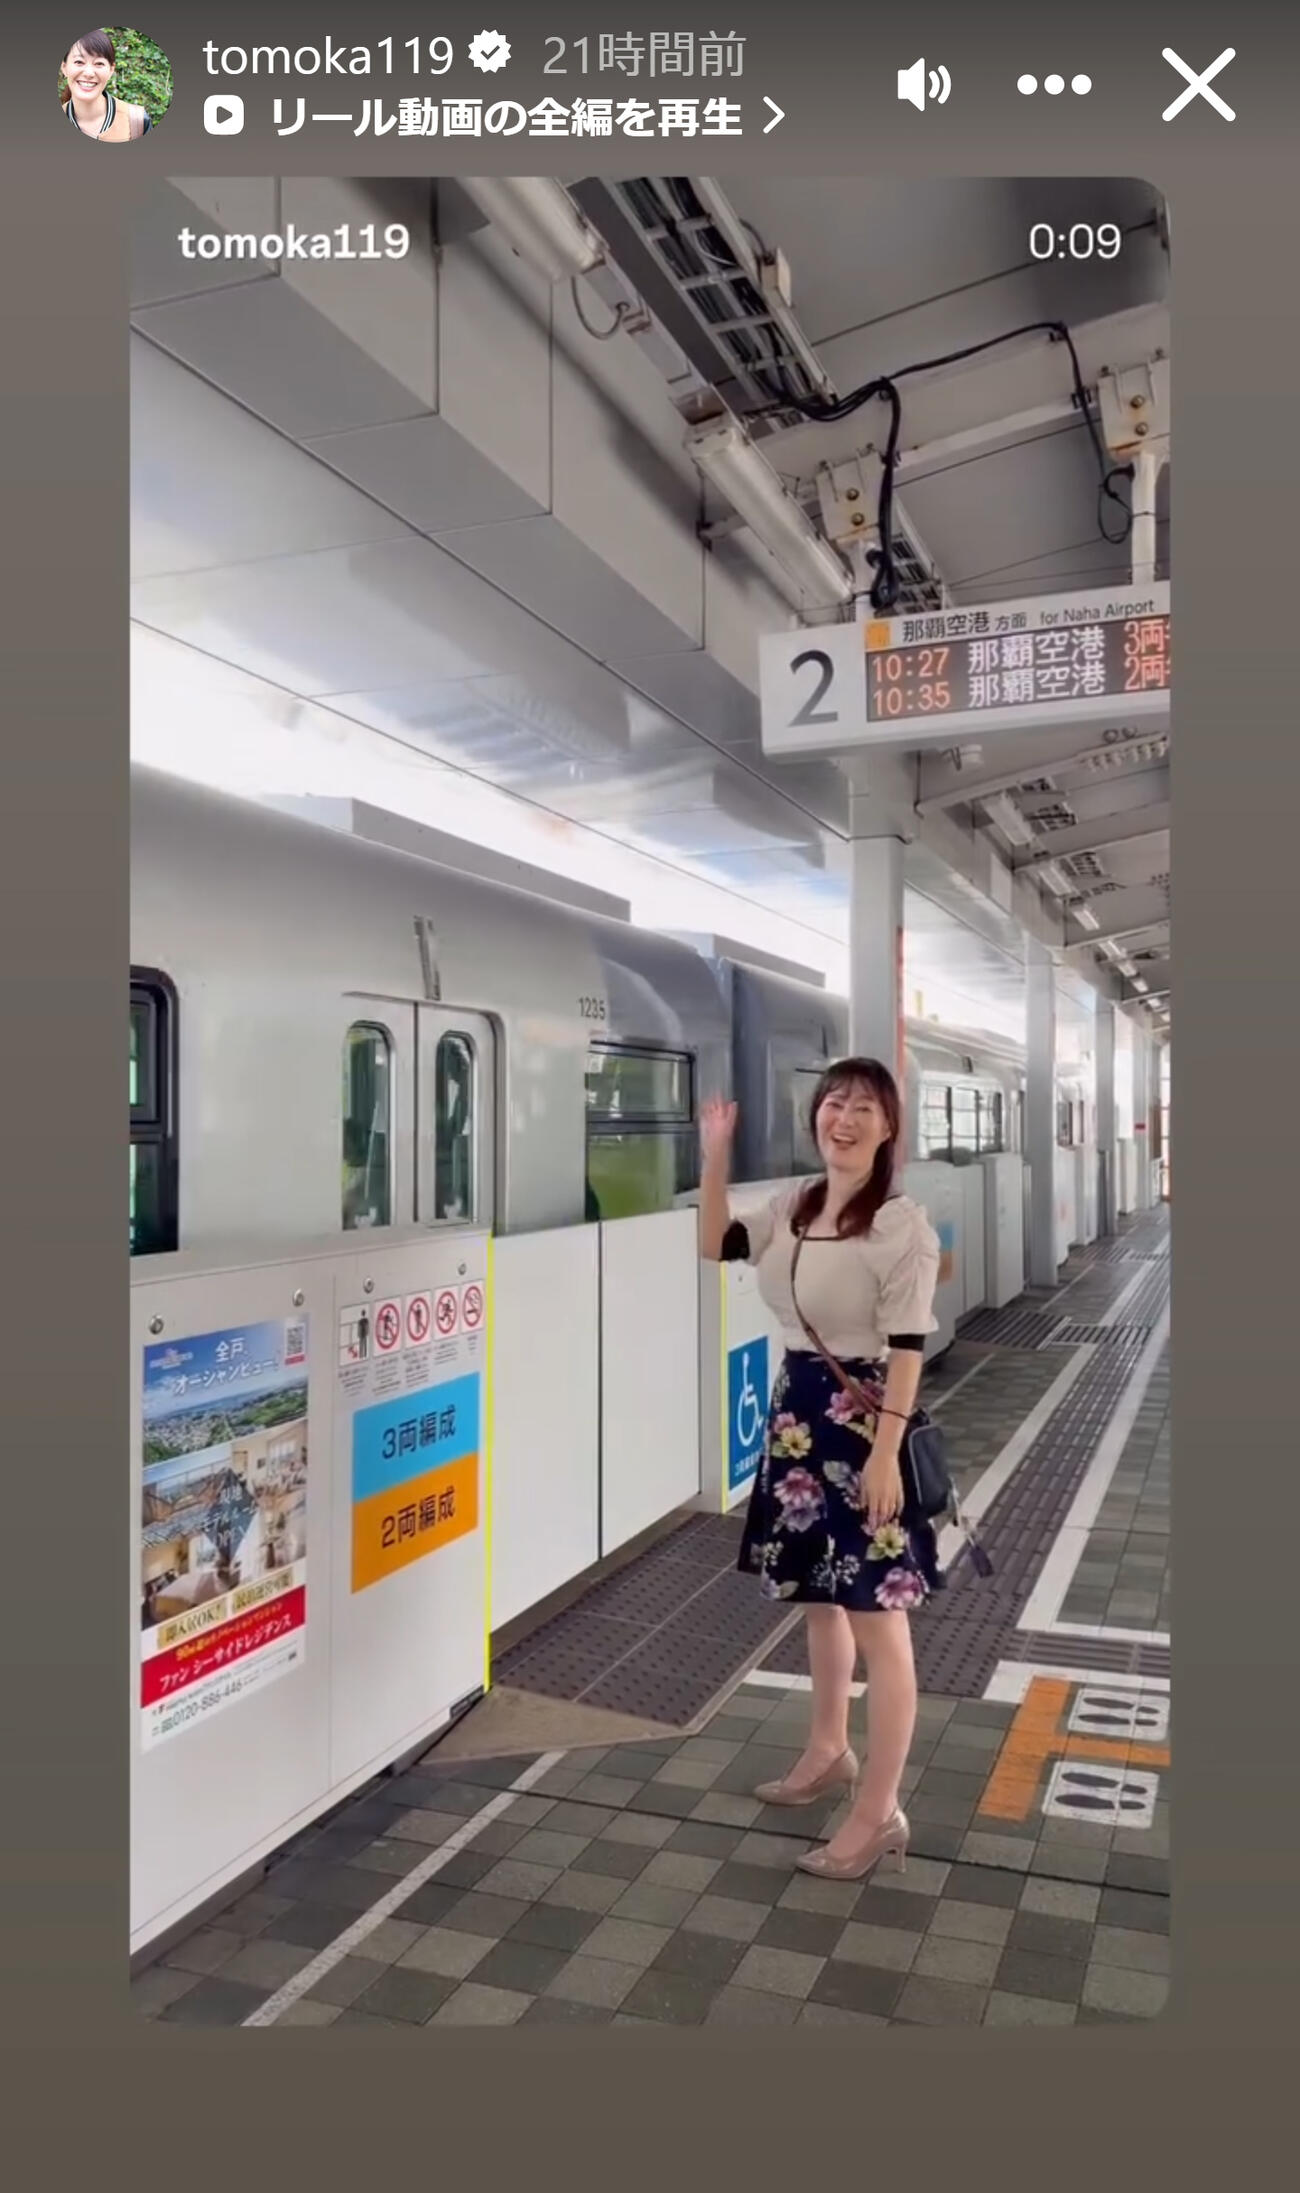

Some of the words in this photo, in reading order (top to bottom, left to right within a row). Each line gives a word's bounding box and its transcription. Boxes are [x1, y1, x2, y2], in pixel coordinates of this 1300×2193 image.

[872, 647, 949, 683] 10:27
[968, 626, 1104, 674] 那覇空港
[1123, 618, 1170, 655] 3両
[903, 612, 989, 642] 那覇空港
[995, 612, 1026, 631] 方面
[1040, 611, 1060, 625] for
[1064, 608, 1100, 624] Naha
[1104, 599, 1154, 618] Airport
[787, 650, 838, 727] 2
[873, 681, 950, 716] 10:35
[968, 661, 1105, 709] 那覇空港
[1124, 653, 1170, 690] 2両
[579, 996, 606, 1020] 1235
[382, 1404, 456, 1460] 3両編成
[381, 1485, 455, 1549] 2両編成
